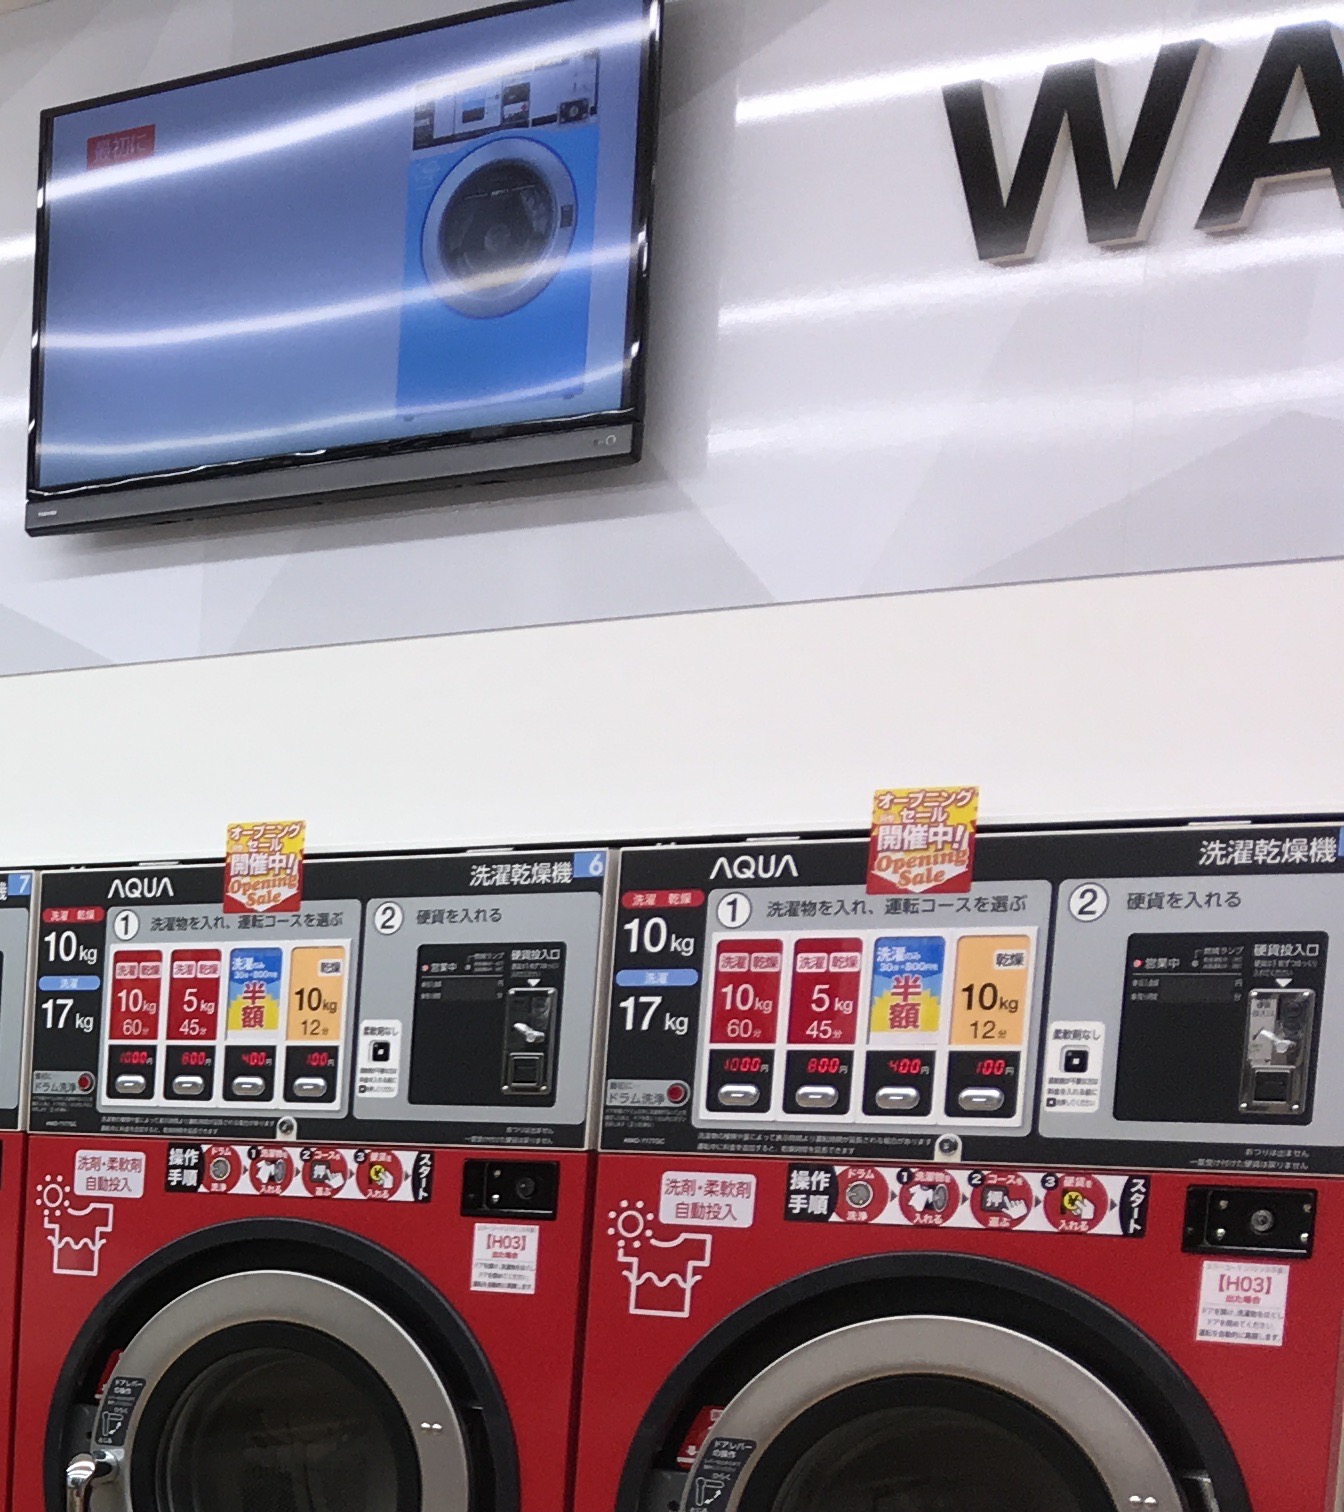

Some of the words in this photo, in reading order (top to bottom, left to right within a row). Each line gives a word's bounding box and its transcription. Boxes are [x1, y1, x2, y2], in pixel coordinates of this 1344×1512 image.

[878, 788, 974, 810] オープニング
[900, 807, 948, 823] セール
[230, 822, 303, 840] オープニング
[875, 849, 968, 874] Opening
[1199, 837, 1337, 865] 洗濯乾燥機
[469, 862, 573, 886] 洗濯乾燥機
[589, 853, 603, 875] 6
[710, 854, 798, 880] AQUA
[19, 875, 30, 894] 7
[108, 877, 174, 899] AQUA
[229, 872, 298, 894] Opening
[897, 867, 946, 888] Sale
[246, 889, 281, 907] Sale
[767, 895, 1029, 917] 洗濯物を入れ、運転コースを選ぶ
[1127, 891, 1242, 910] 硬貨を入れる
[416, 908, 502, 924] 硬貨を入れる
[623, 916, 695, 957] 10kg
[44, 931, 98, 965] 10kg
[721, 983, 773, 1014] 10kg
[961, 982, 1019, 1014] 10kg
[41, 999, 94, 1032] 17kg
[619, 996, 689, 1035] 17kg
[77, 1154, 142, 1174] 洗剤・柔軟剤
[85, 1175, 132, 1193] 自動投入
[664, 1178, 752, 1200] 洗剤・柔軟剤
[790, 1170, 831, 1192] 操作
[675, 1202, 738, 1222] 自動投入
[788, 1194, 829, 1215] 手順
[1128, 1178, 1146, 1234] スタート
